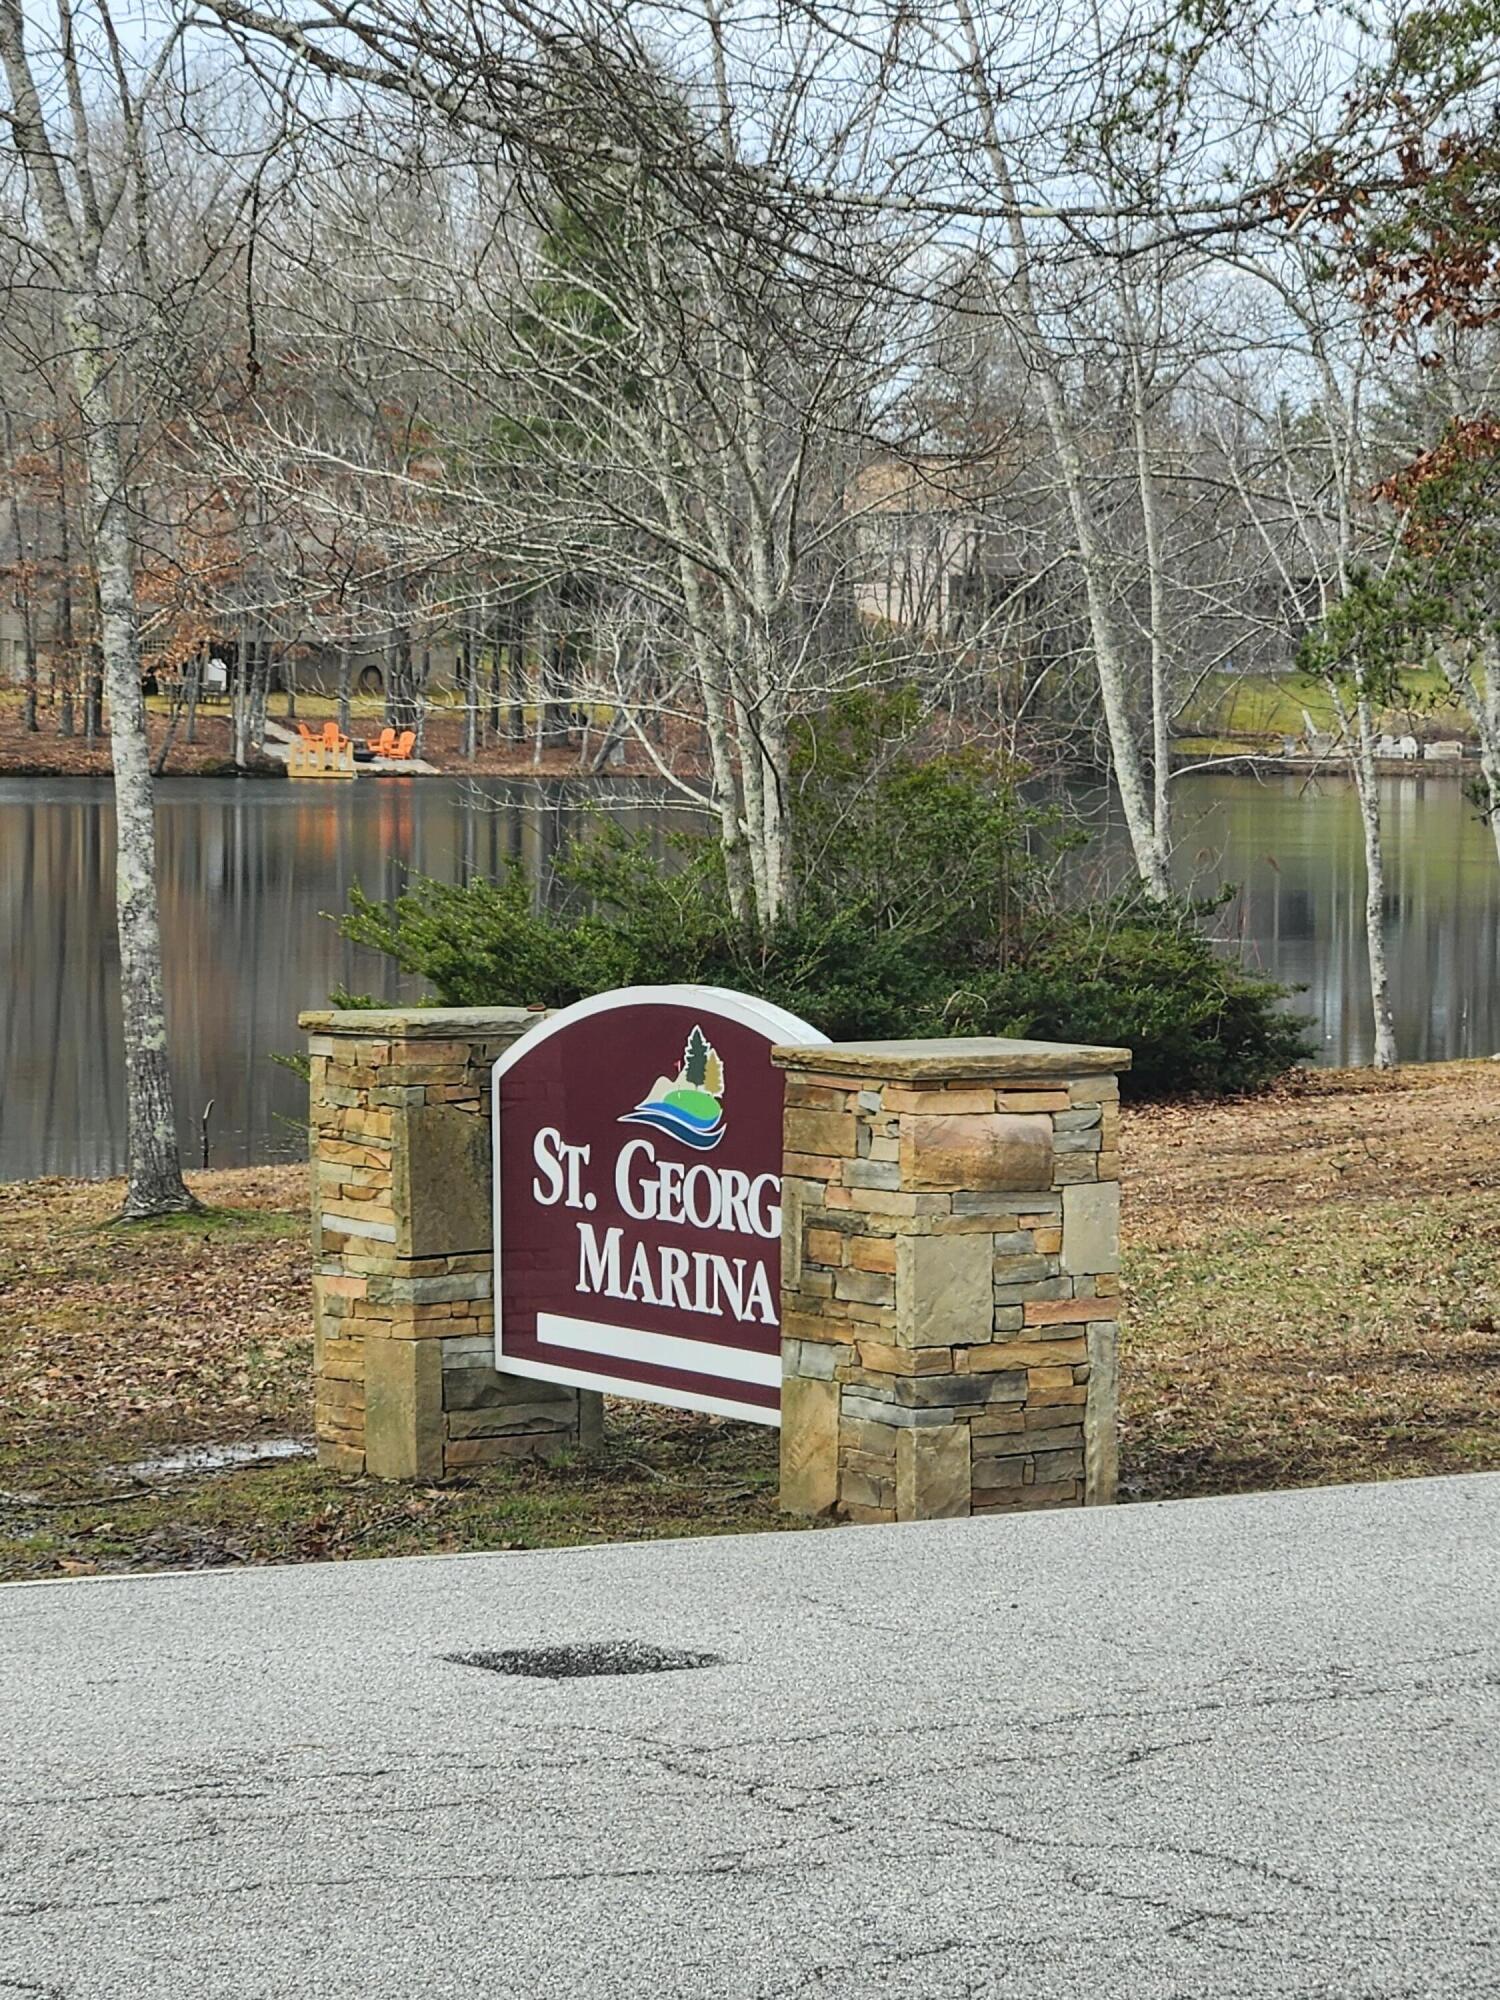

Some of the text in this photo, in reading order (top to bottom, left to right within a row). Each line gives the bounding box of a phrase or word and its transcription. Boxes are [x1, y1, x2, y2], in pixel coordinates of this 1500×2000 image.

[533, 1126, 784, 1239] ST. GEORG
[575, 1222, 780, 1326] MARINA
